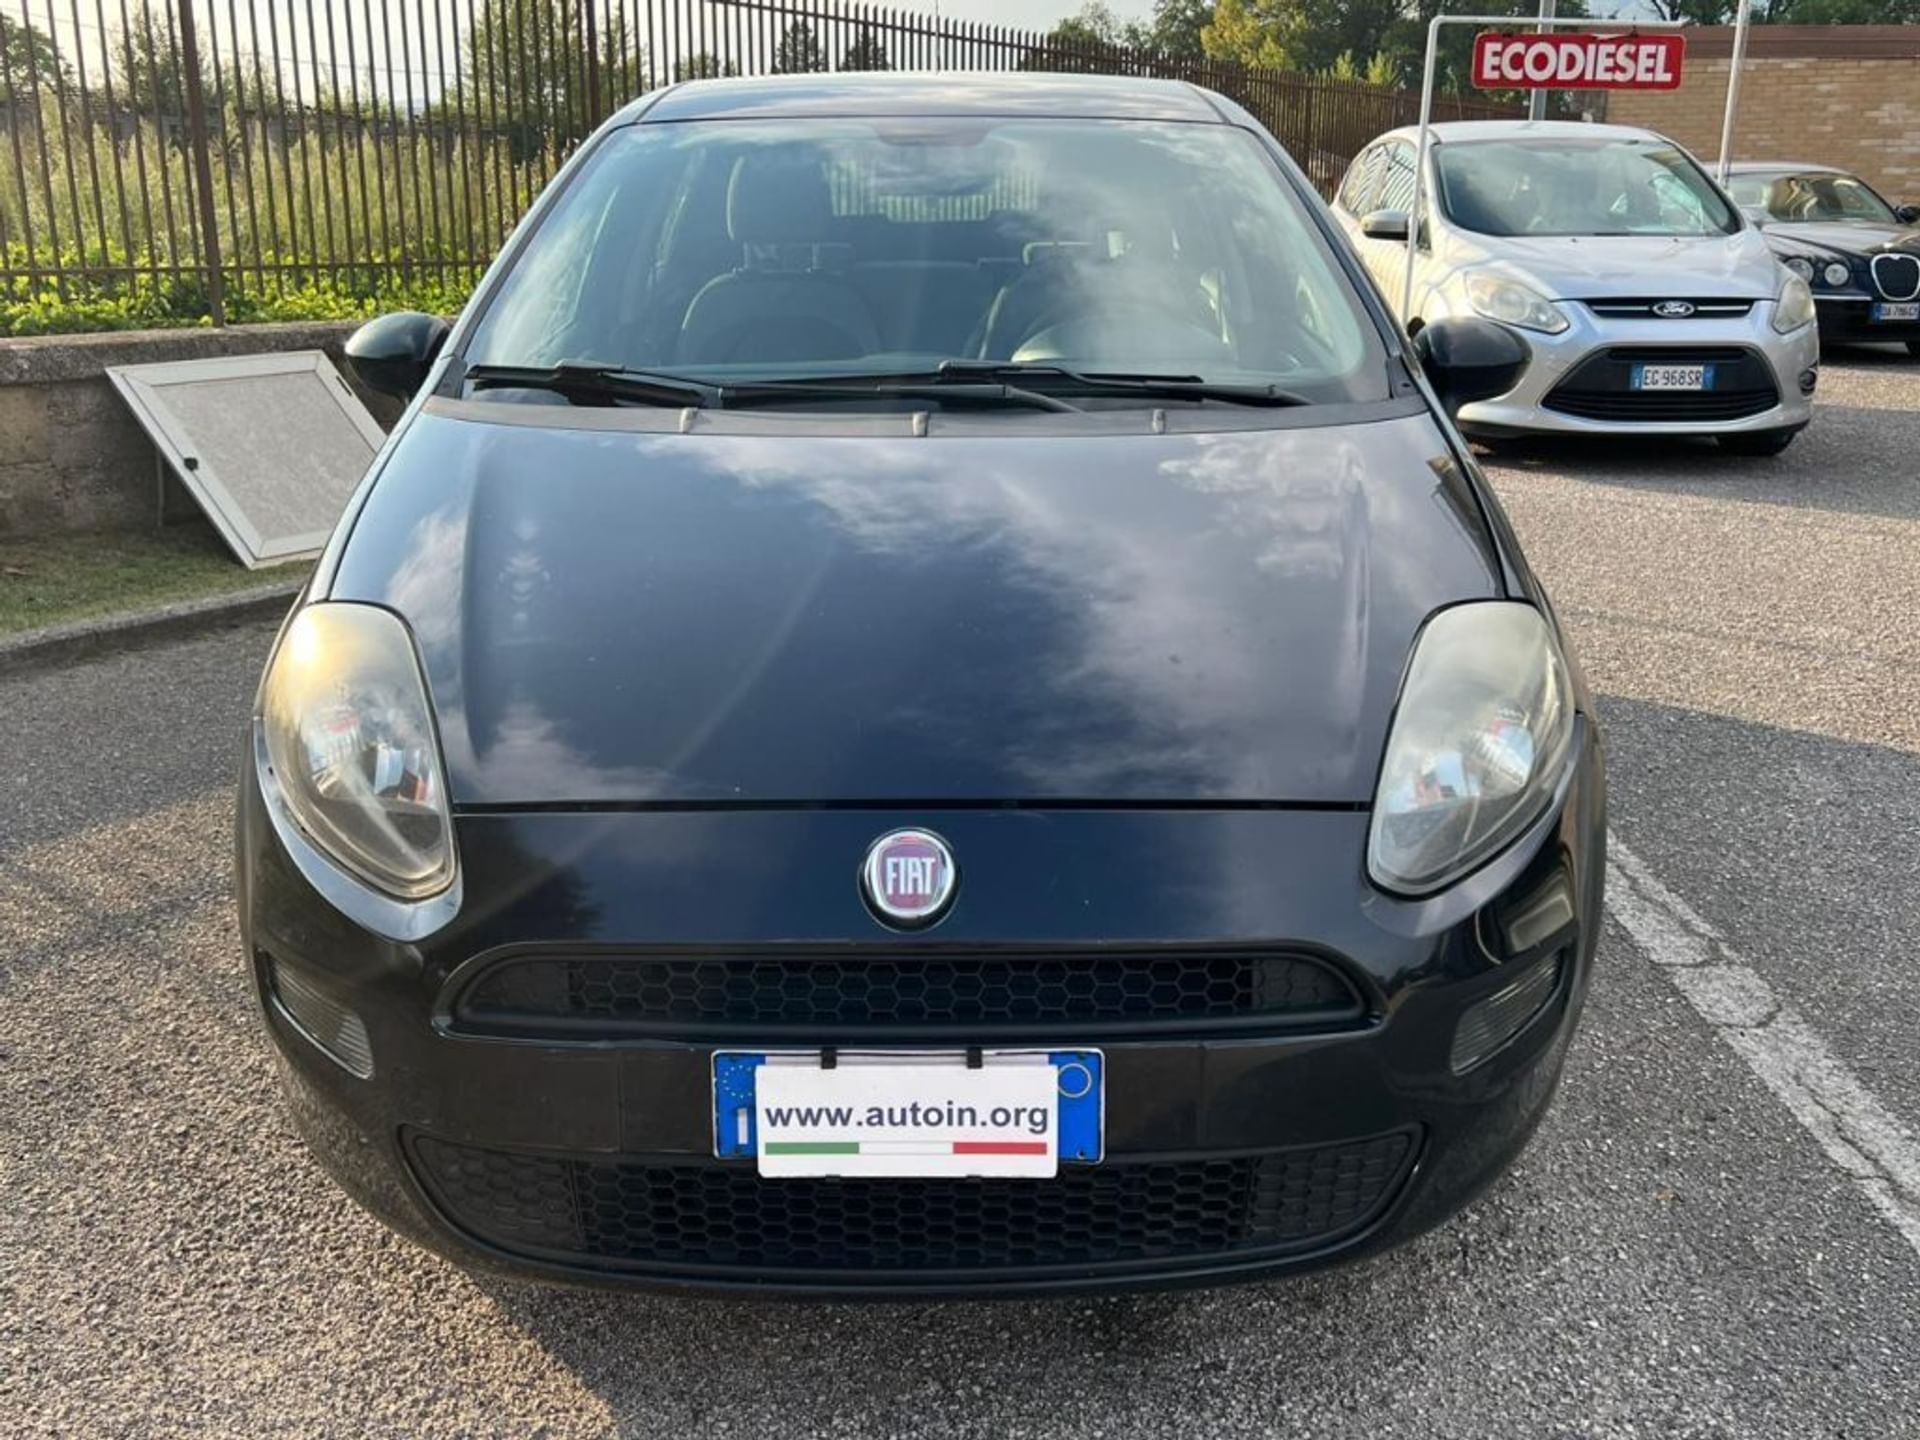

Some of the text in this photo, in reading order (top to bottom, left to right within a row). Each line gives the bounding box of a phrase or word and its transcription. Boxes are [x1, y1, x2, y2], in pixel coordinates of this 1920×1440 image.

[1482, 42, 1672, 82] ECODIESEL
[886, 857, 936, 895] FIAT
[765, 1100, 1049, 1134] www.autoin.org
